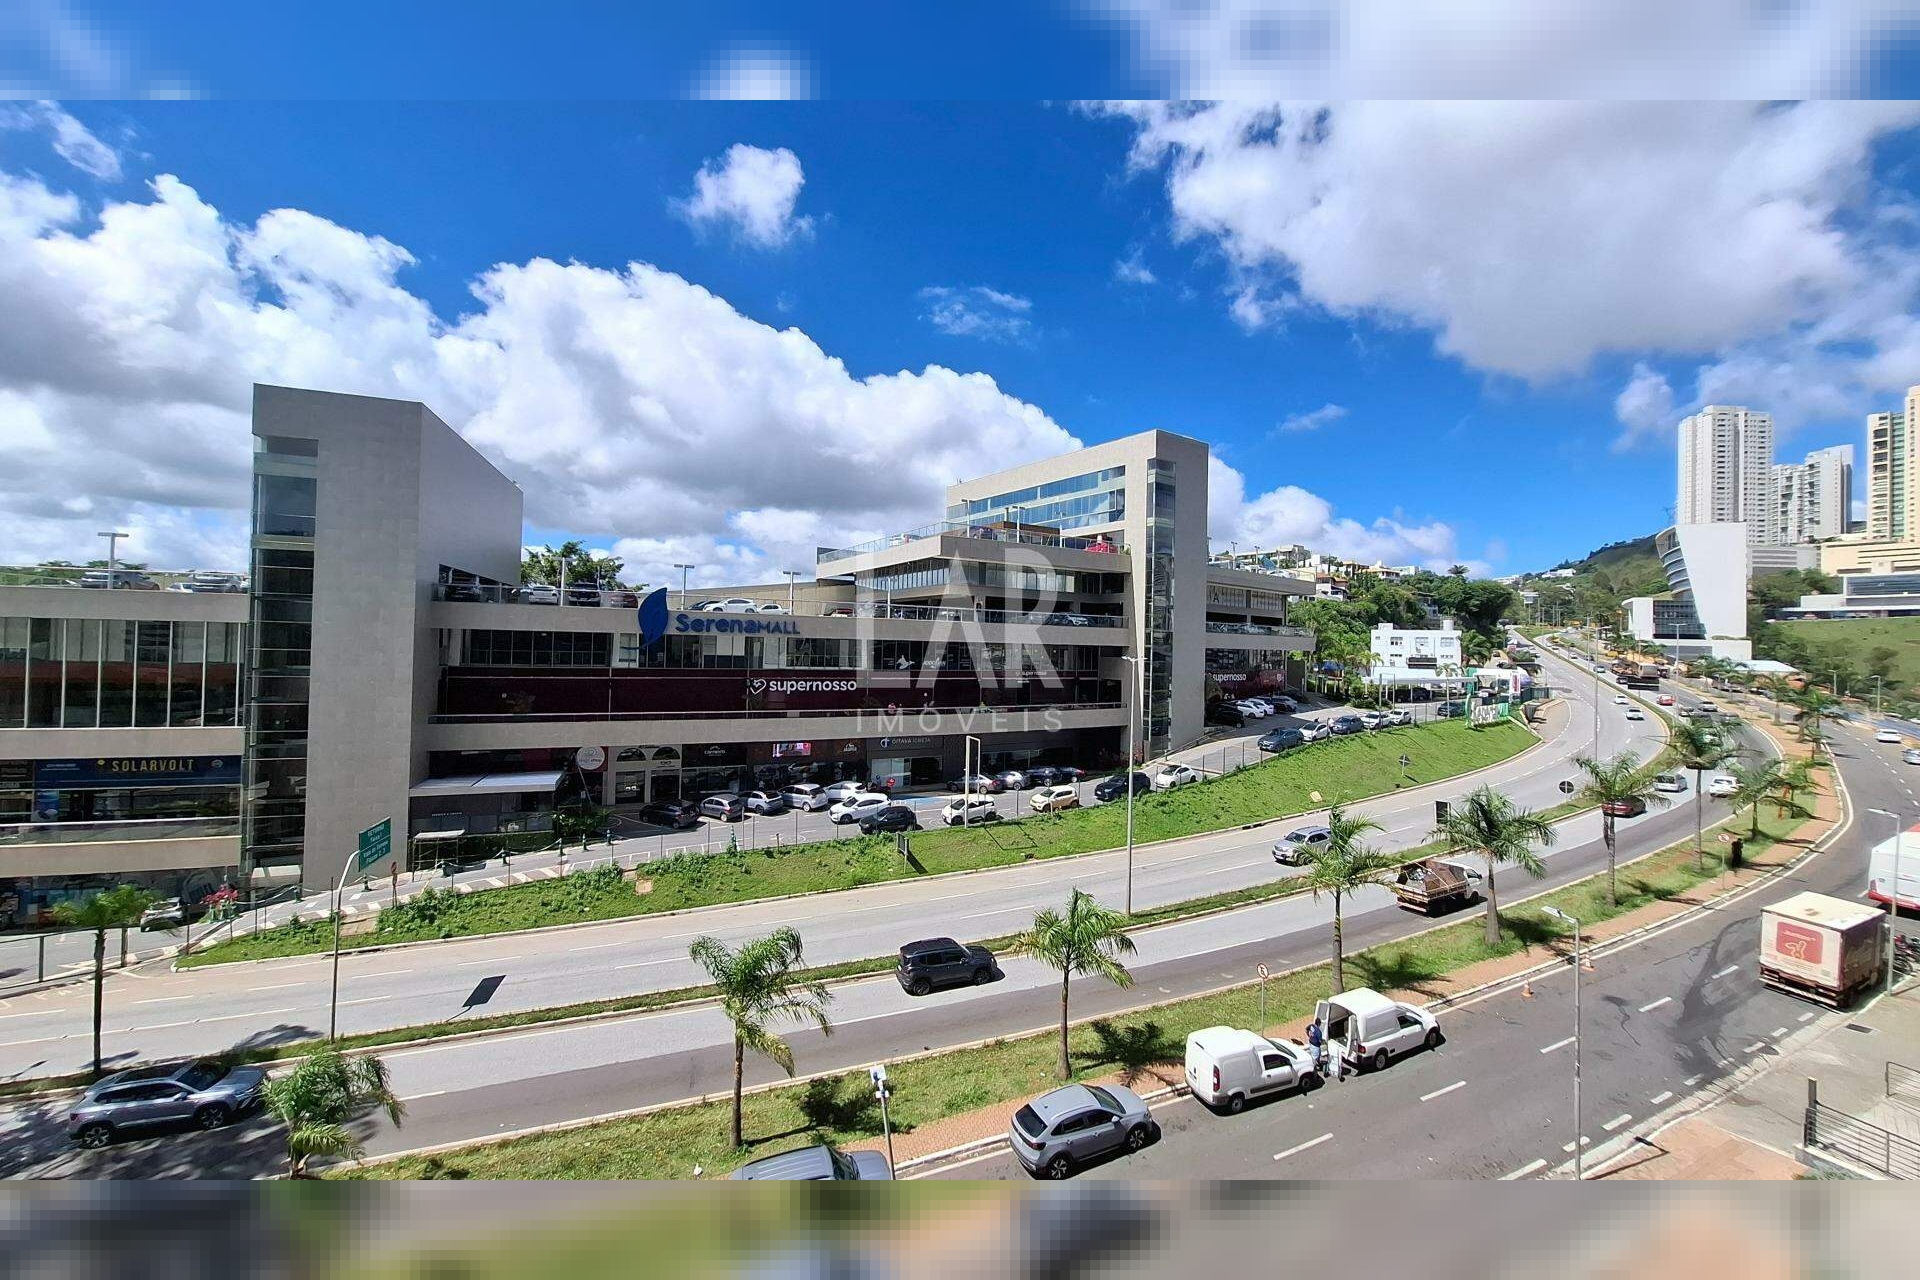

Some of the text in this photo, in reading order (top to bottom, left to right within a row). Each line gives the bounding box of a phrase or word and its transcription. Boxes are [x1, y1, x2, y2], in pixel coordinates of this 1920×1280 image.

[1213, 673, 1246, 683] supernosso
[769, 680, 857, 694] supernosso
[112, 759, 194, 772] SOLARVOLT
